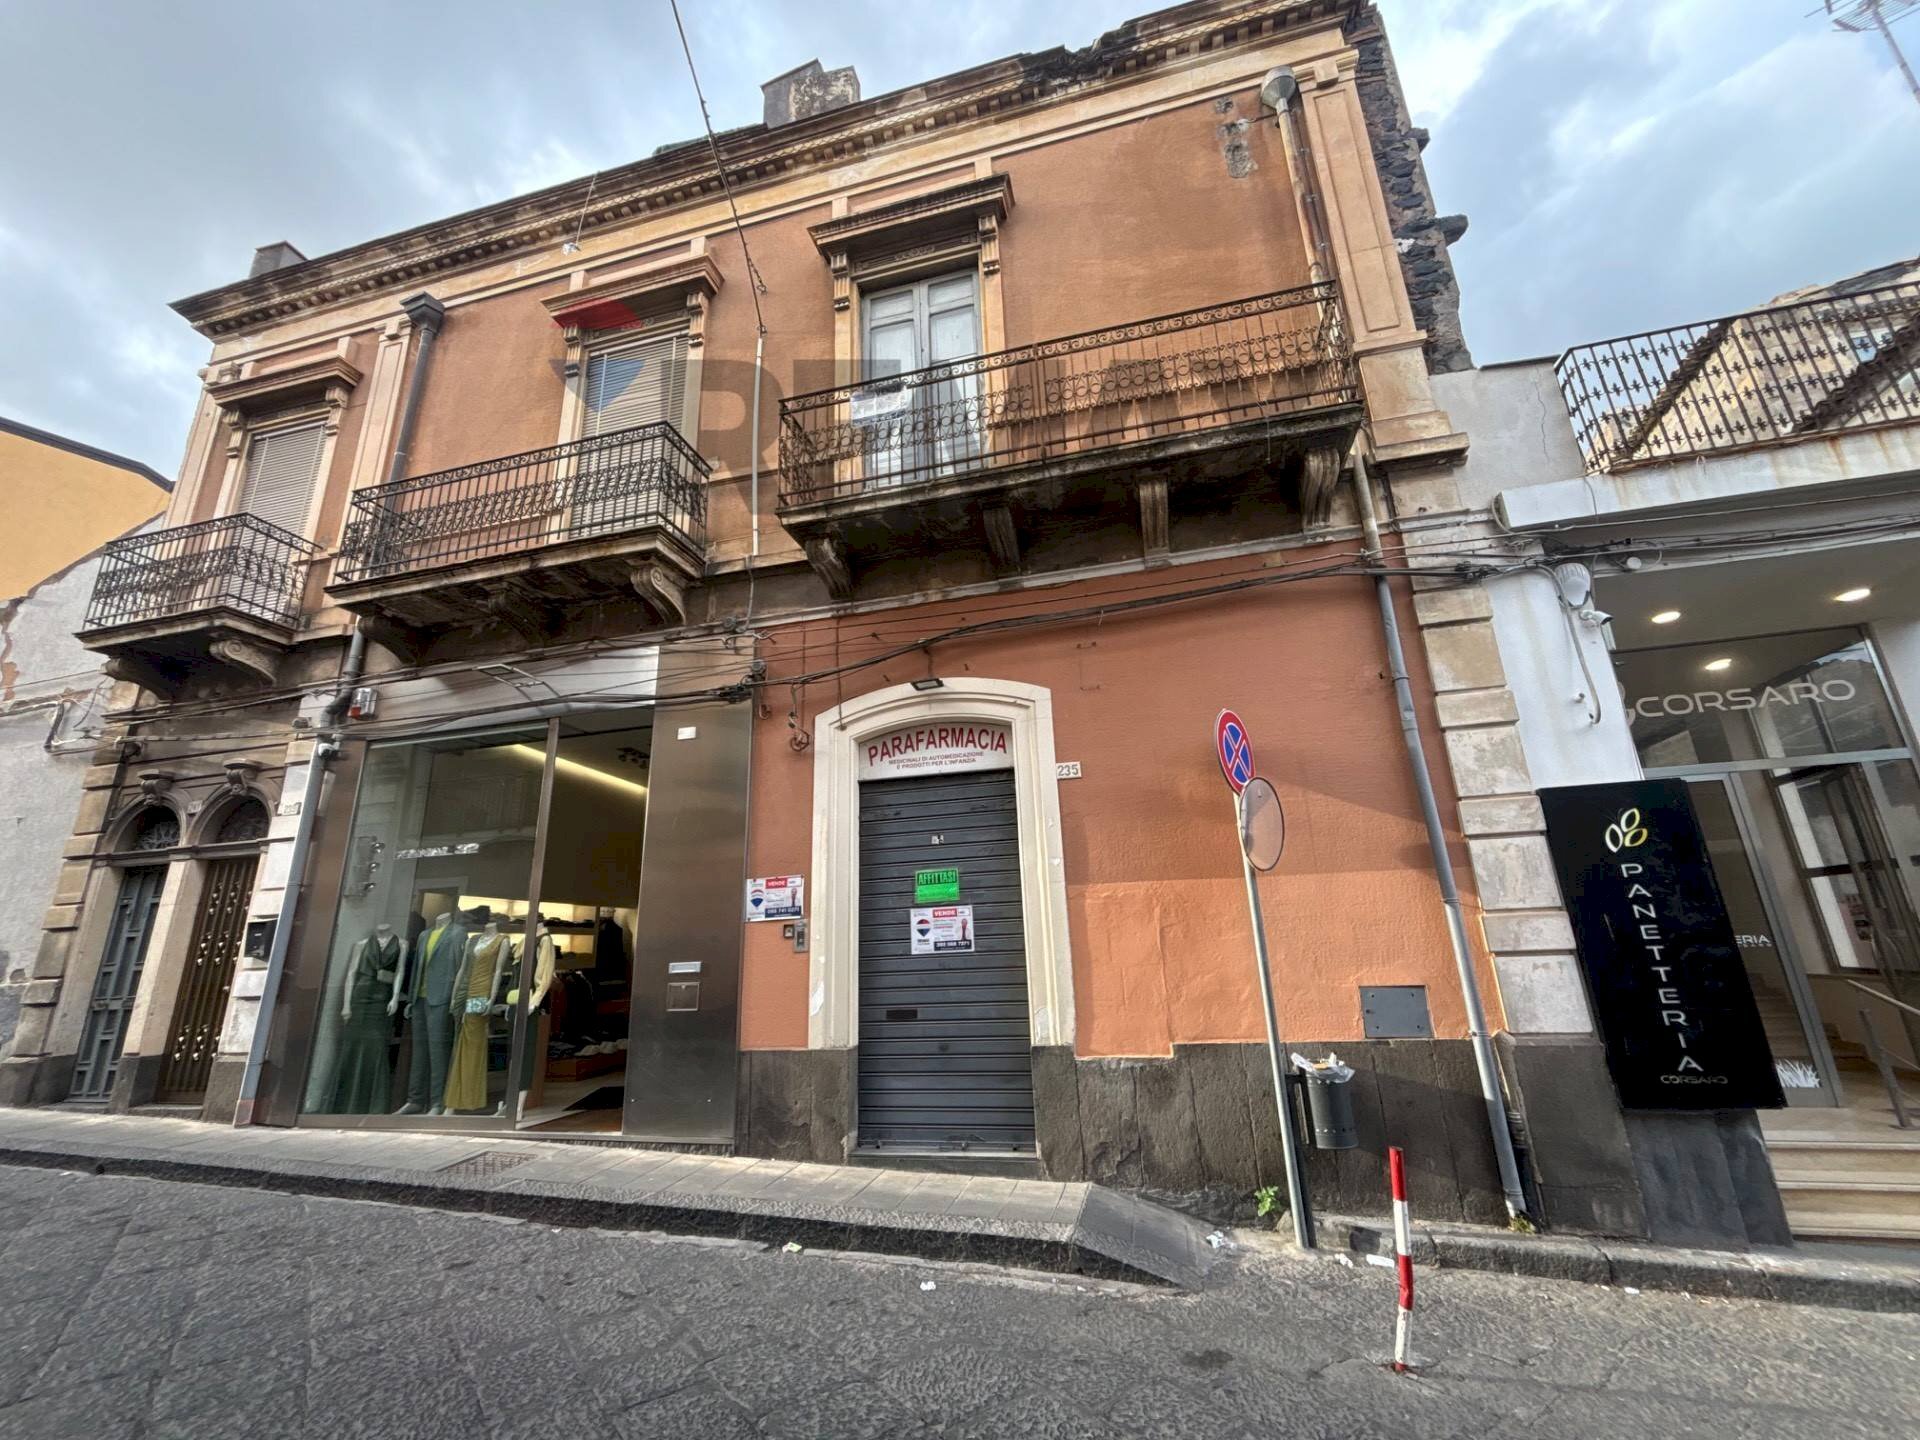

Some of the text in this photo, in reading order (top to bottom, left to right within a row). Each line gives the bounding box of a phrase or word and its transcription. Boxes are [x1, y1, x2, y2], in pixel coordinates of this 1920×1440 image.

[1636, 679, 1856, 718] CORSARO
[868, 727, 1007, 766] PARAFARMACIA
[889, 756, 921, 766] MEDICINALI
[929, 751, 985, 760] AUTOMEDICAZIONE
[1057, 764, 1078, 776] 235
[918, 871, 956, 885] AFFITTASI
[1620, 863, 1704, 1072] PANETTERIA
[1660, 1075, 1728, 1085] CORSARO
